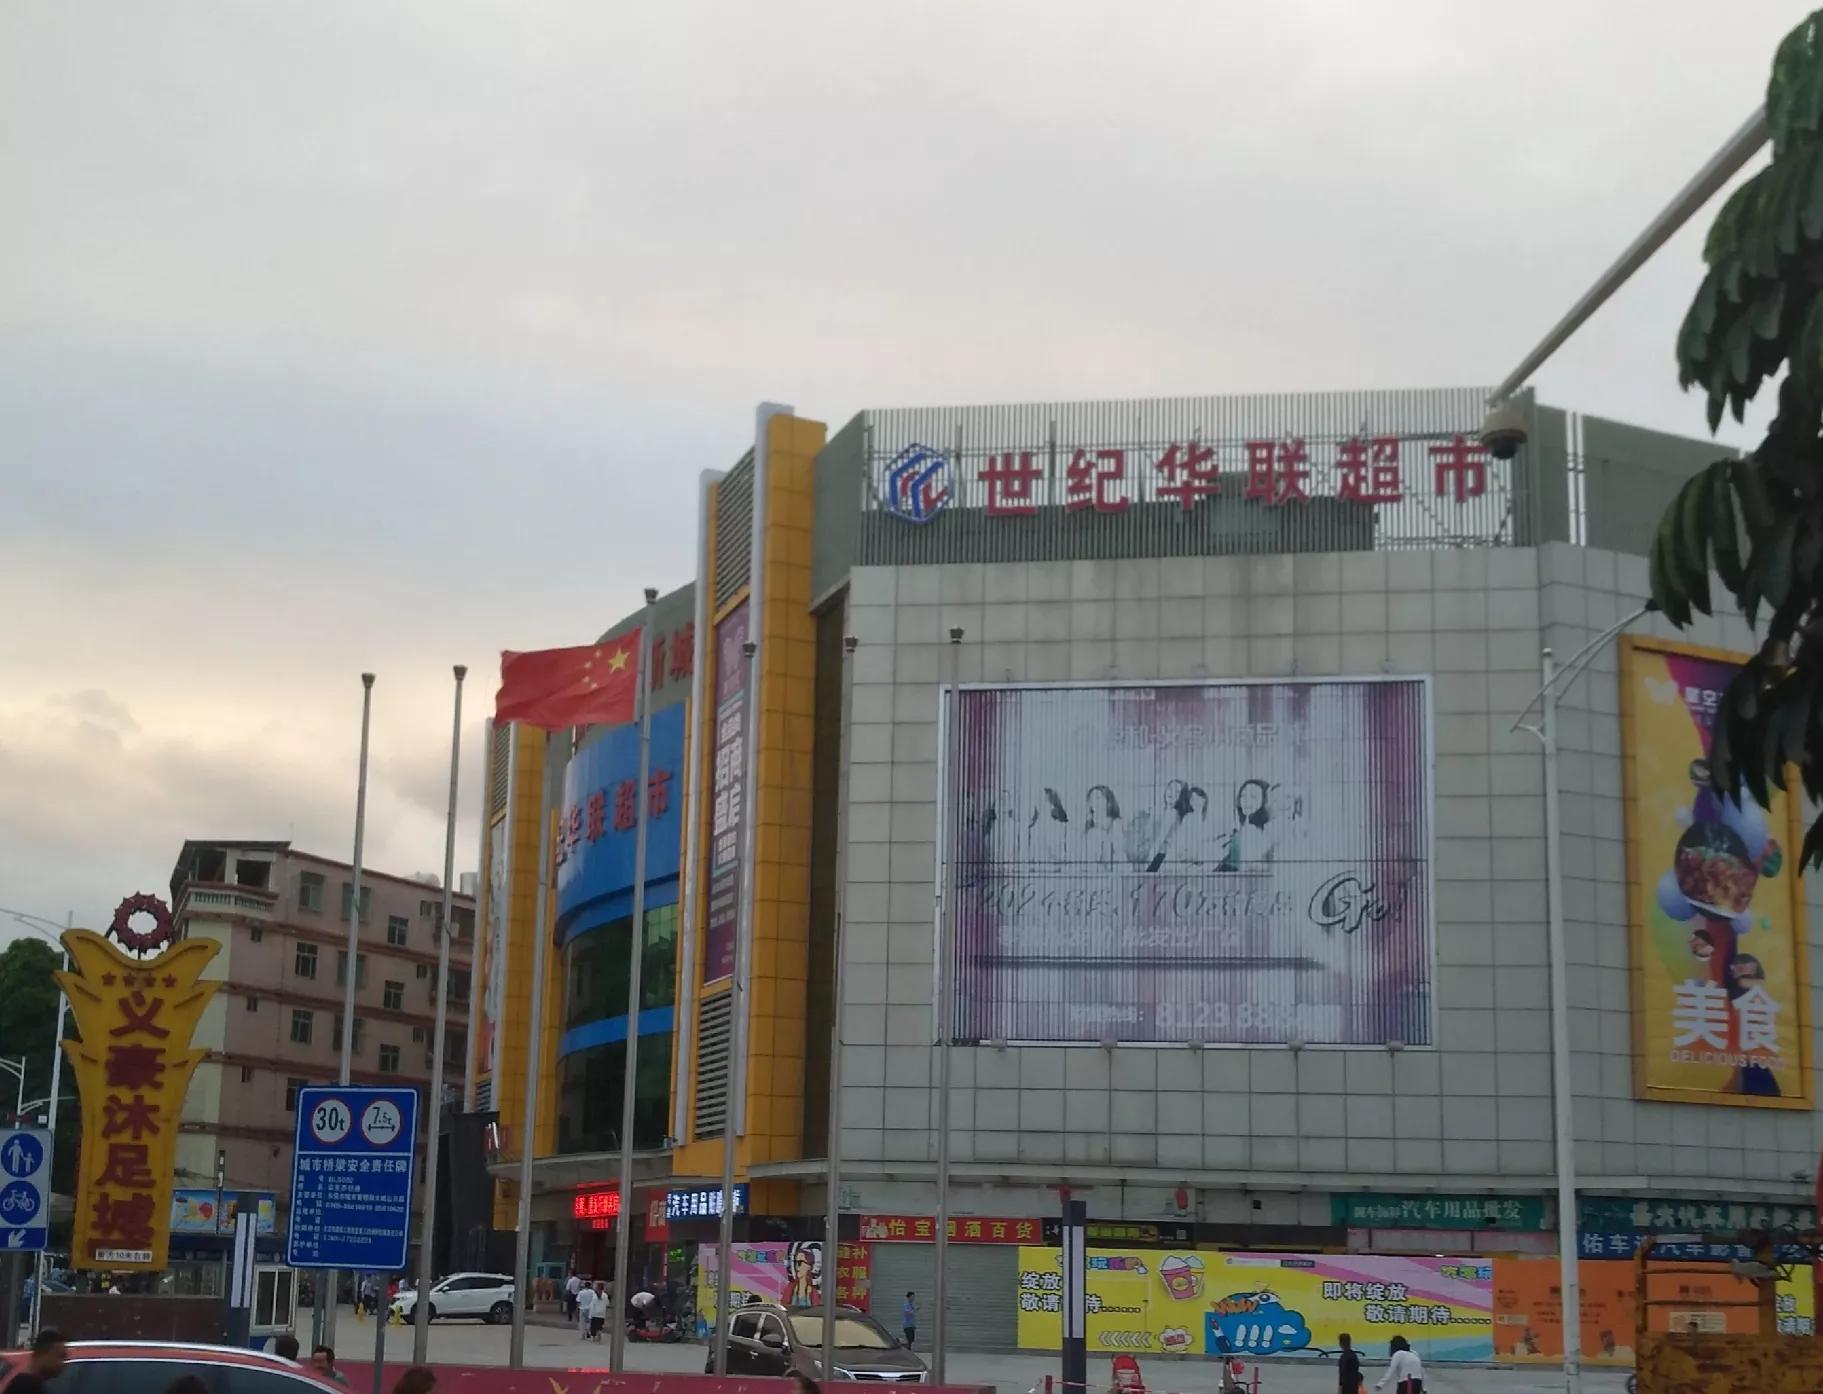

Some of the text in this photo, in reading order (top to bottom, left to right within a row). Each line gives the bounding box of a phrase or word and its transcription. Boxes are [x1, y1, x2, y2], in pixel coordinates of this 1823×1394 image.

[977, 434, 1488, 518] 世纪华联超市
[1672, 978, 1781, 1051] 美食
[315, 1106, 345, 1132] 30t
[1020, 1271, 1062, 1290] 绽放
[1322, 1280, 1408, 1302] 即将绽放
